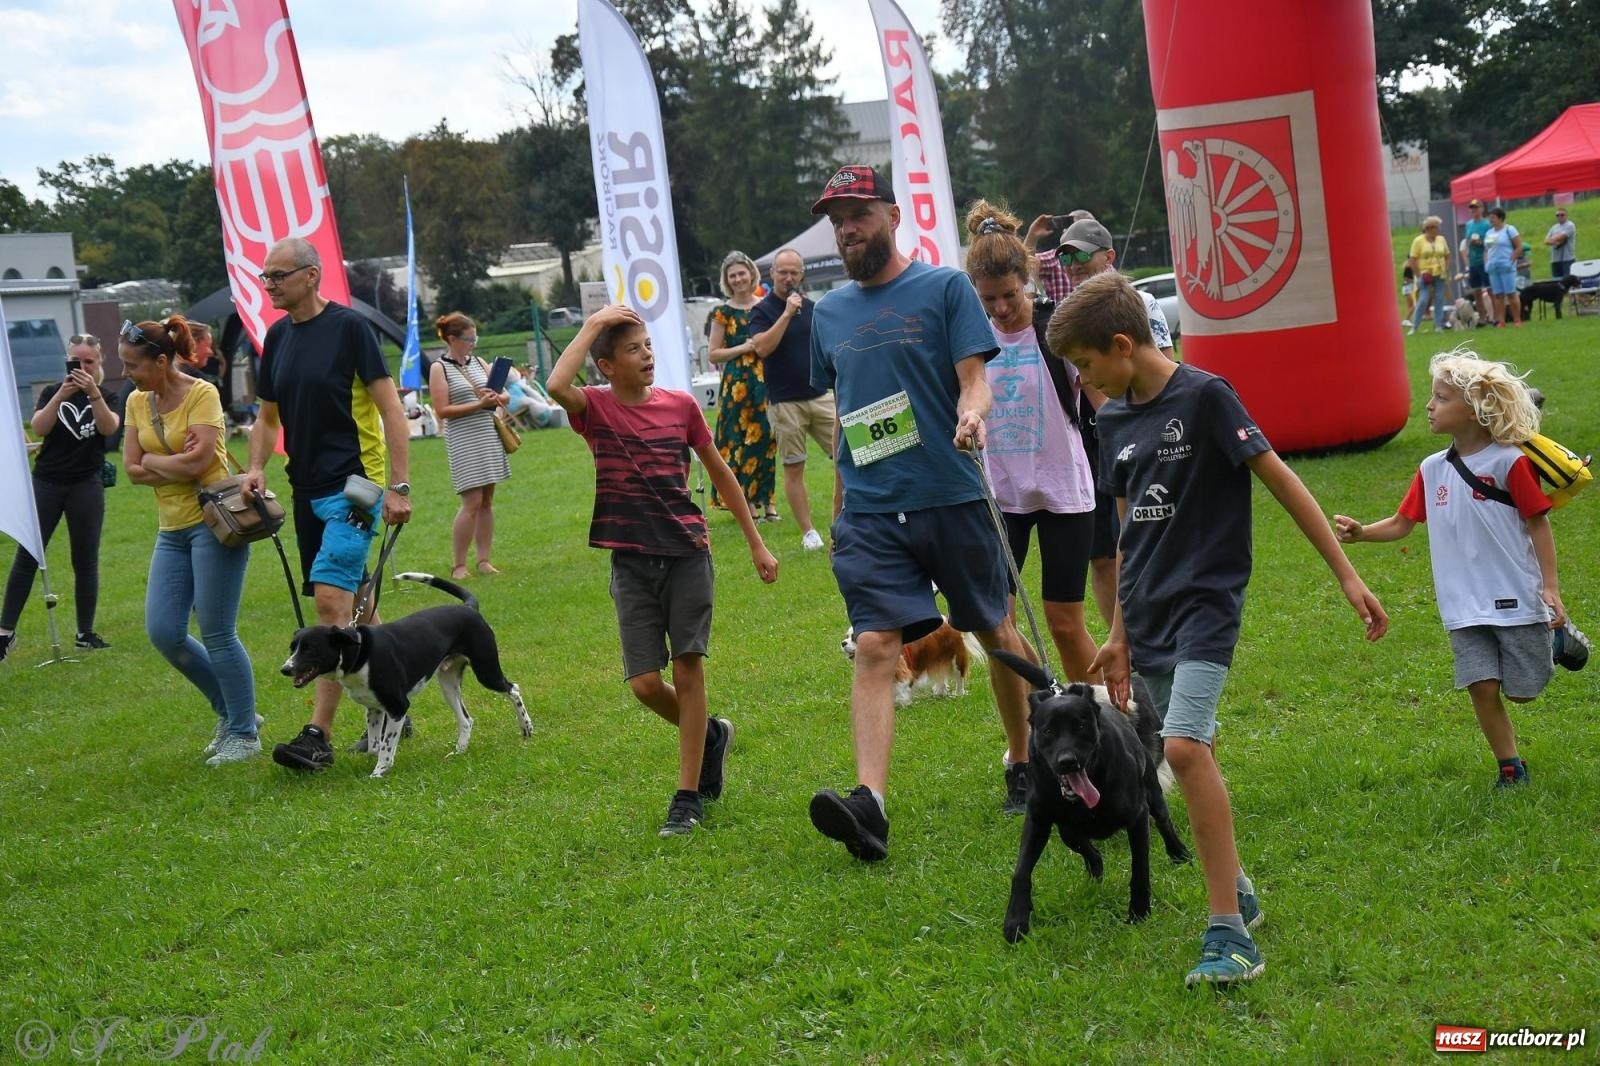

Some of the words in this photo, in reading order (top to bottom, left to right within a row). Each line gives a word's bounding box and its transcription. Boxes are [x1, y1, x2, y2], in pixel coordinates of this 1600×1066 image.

[706, 388, 716, 407] 2
[869, 417, 898, 441] 86
[1157, 444, 1192, 456] POLAND
[1158, 452, 1193, 463] VOLLEYBALL
[1134, 506, 1173, 519] ORLEN
